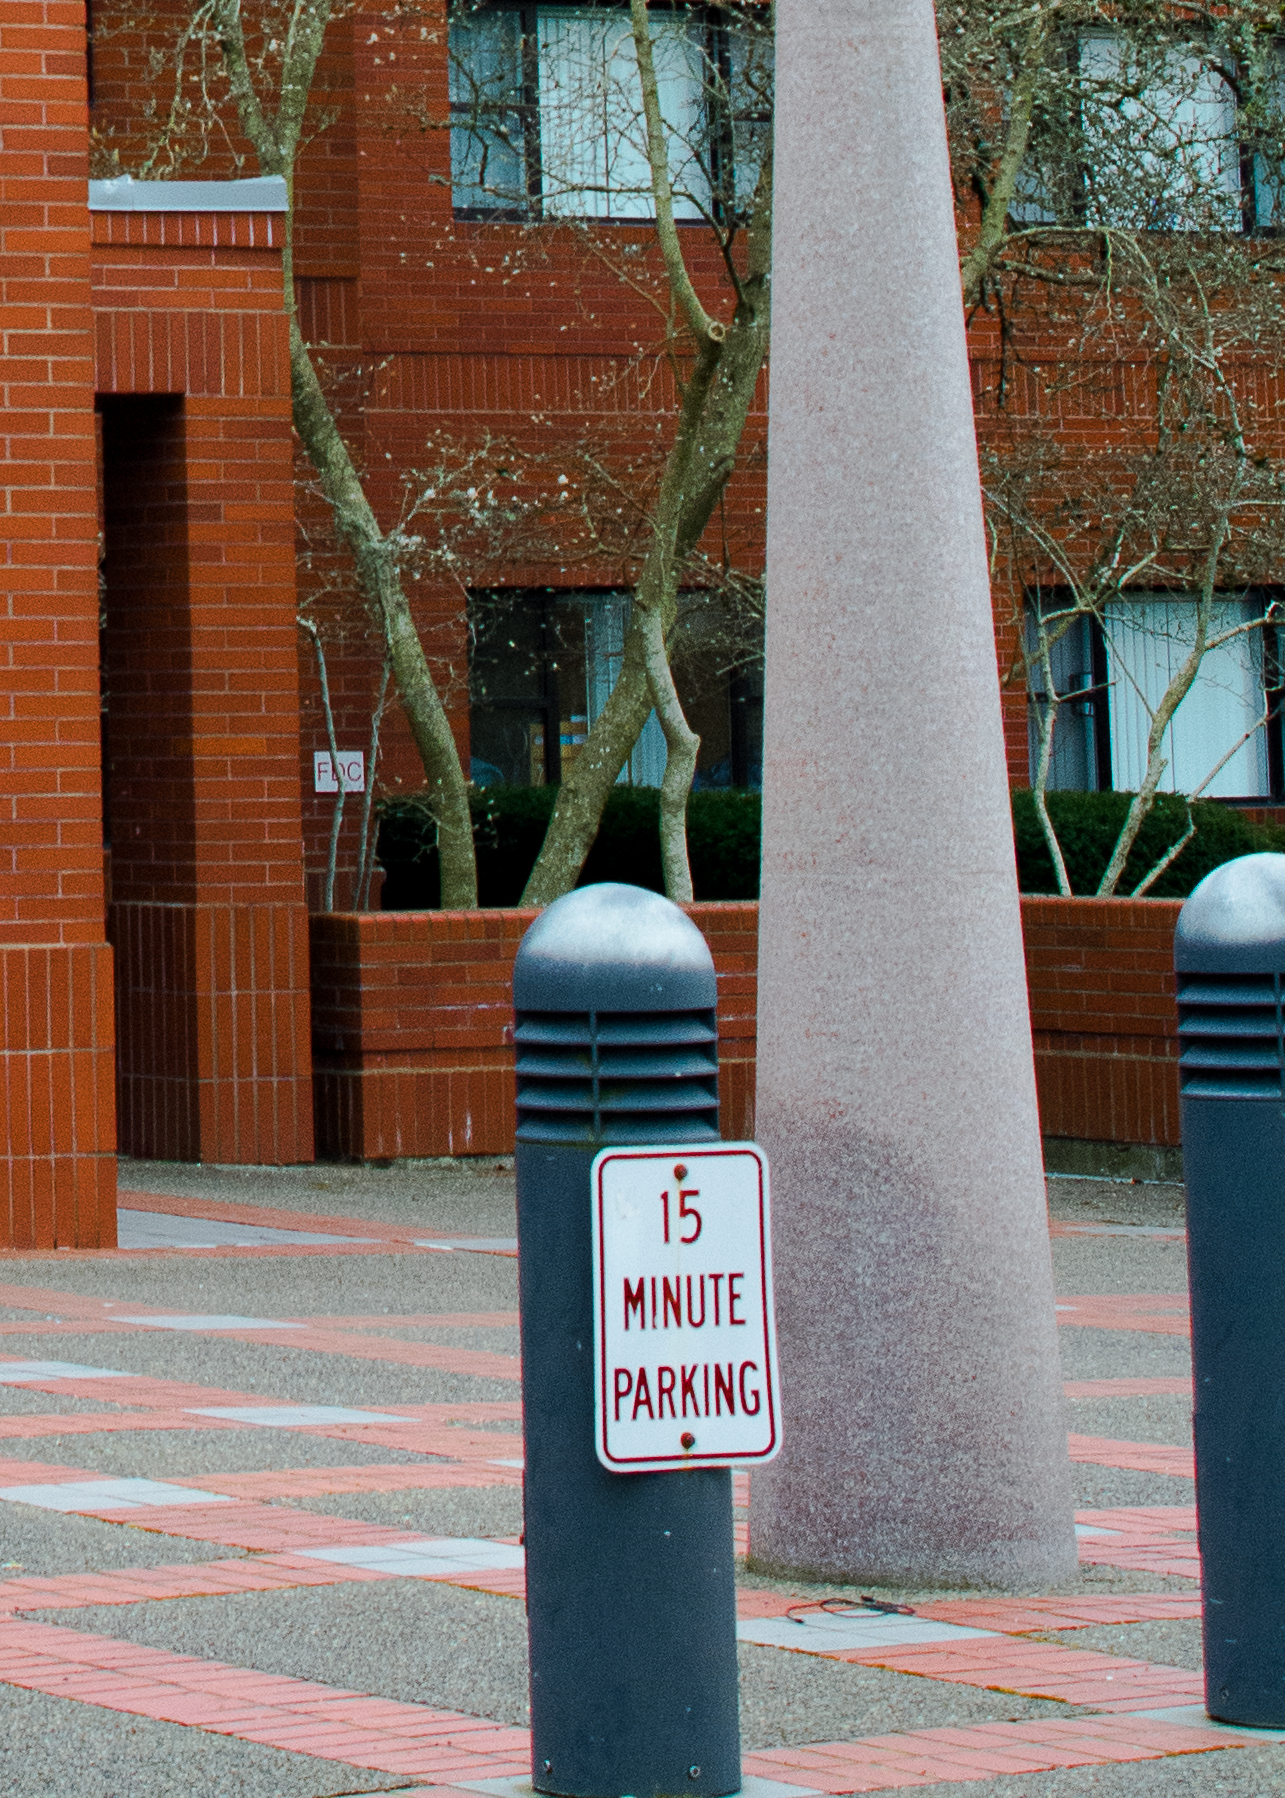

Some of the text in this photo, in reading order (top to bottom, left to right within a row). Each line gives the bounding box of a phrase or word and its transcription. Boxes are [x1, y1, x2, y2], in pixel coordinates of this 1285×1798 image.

[660, 1189, 703, 1244] 15
[623, 1272, 747, 1331] MINUTE
[614, 1360, 761, 1421] PARKING
